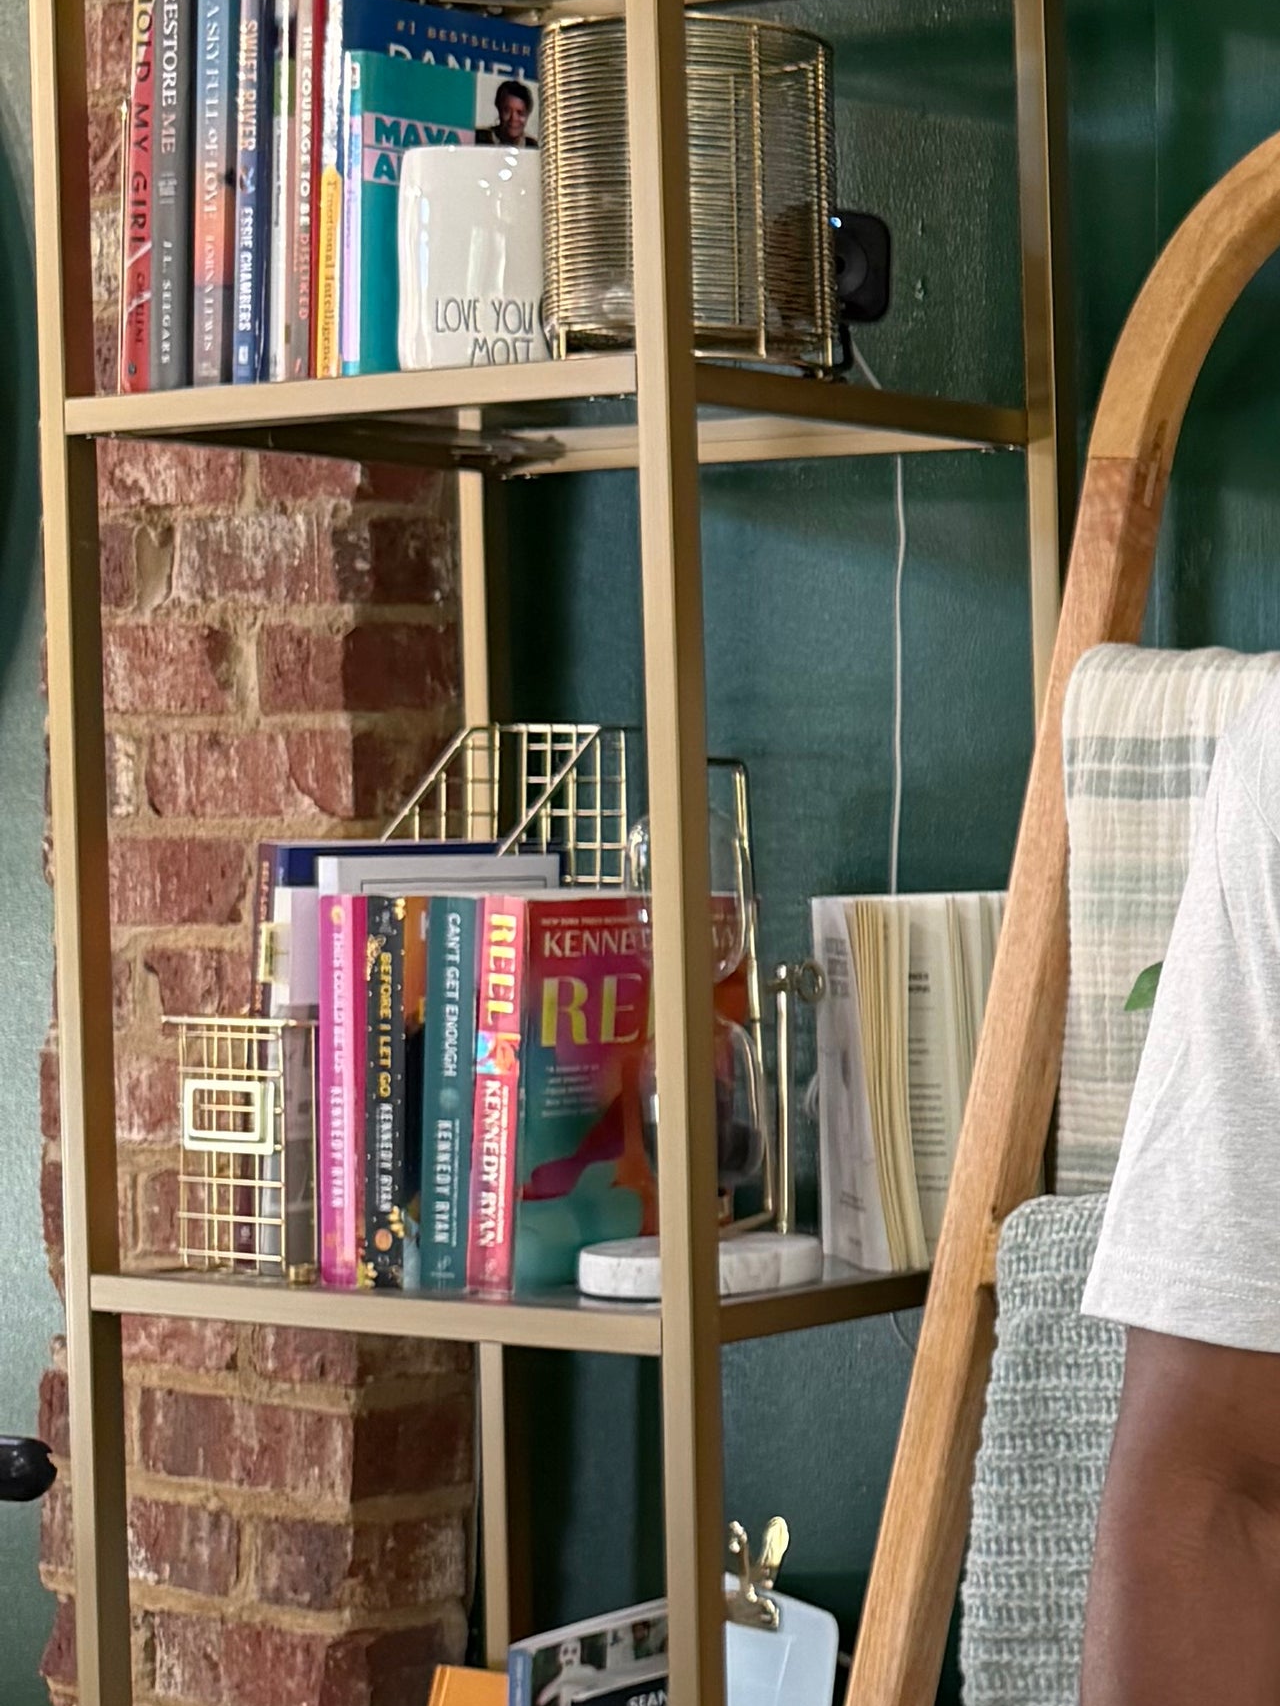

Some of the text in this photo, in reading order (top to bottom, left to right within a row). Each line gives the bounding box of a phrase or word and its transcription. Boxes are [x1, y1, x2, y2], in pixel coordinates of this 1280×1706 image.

[205, 0, 220, 19] A
[205, 20, 220, 62] SKY
[427, 26, 531, 57] BESTSELLER
[204, 67, 220, 125] FULL
[238, 19, 259, 152] SWIFT RIVER
[133, 102, 151, 153] MY
[160, 114, 177, 154] ME
[374, 116, 462, 146] MAYA
[203, 162, 219, 218] LOVE
[298, 25, 313, 321] THE COURAGE TO BE DISLIKED
[238, 206, 254, 333] ESSIE CHAMBERS
[320, 274, 336, 377] Intelligence
[435, 297, 535, 336] LOVE YOU
[378, 951, 393, 1021] BEFORE
[443, 912, 461, 1077] CAN'T GET ENOUGH
[486, 913, 517, 1026] REEL
[540, 972, 655, 1048] RE
[377, 1071, 392, 1098] GO
[378, 1035, 392, 1069] LET
[330, 1085, 344, 1208] KENNEDY RYAN
[379, 1102, 393, 1212] KENNEDY RYAN
[434, 1119, 452, 1244] KENNEDY RYAN
[479, 1079, 502, 1249] KENNEDY RYAN
